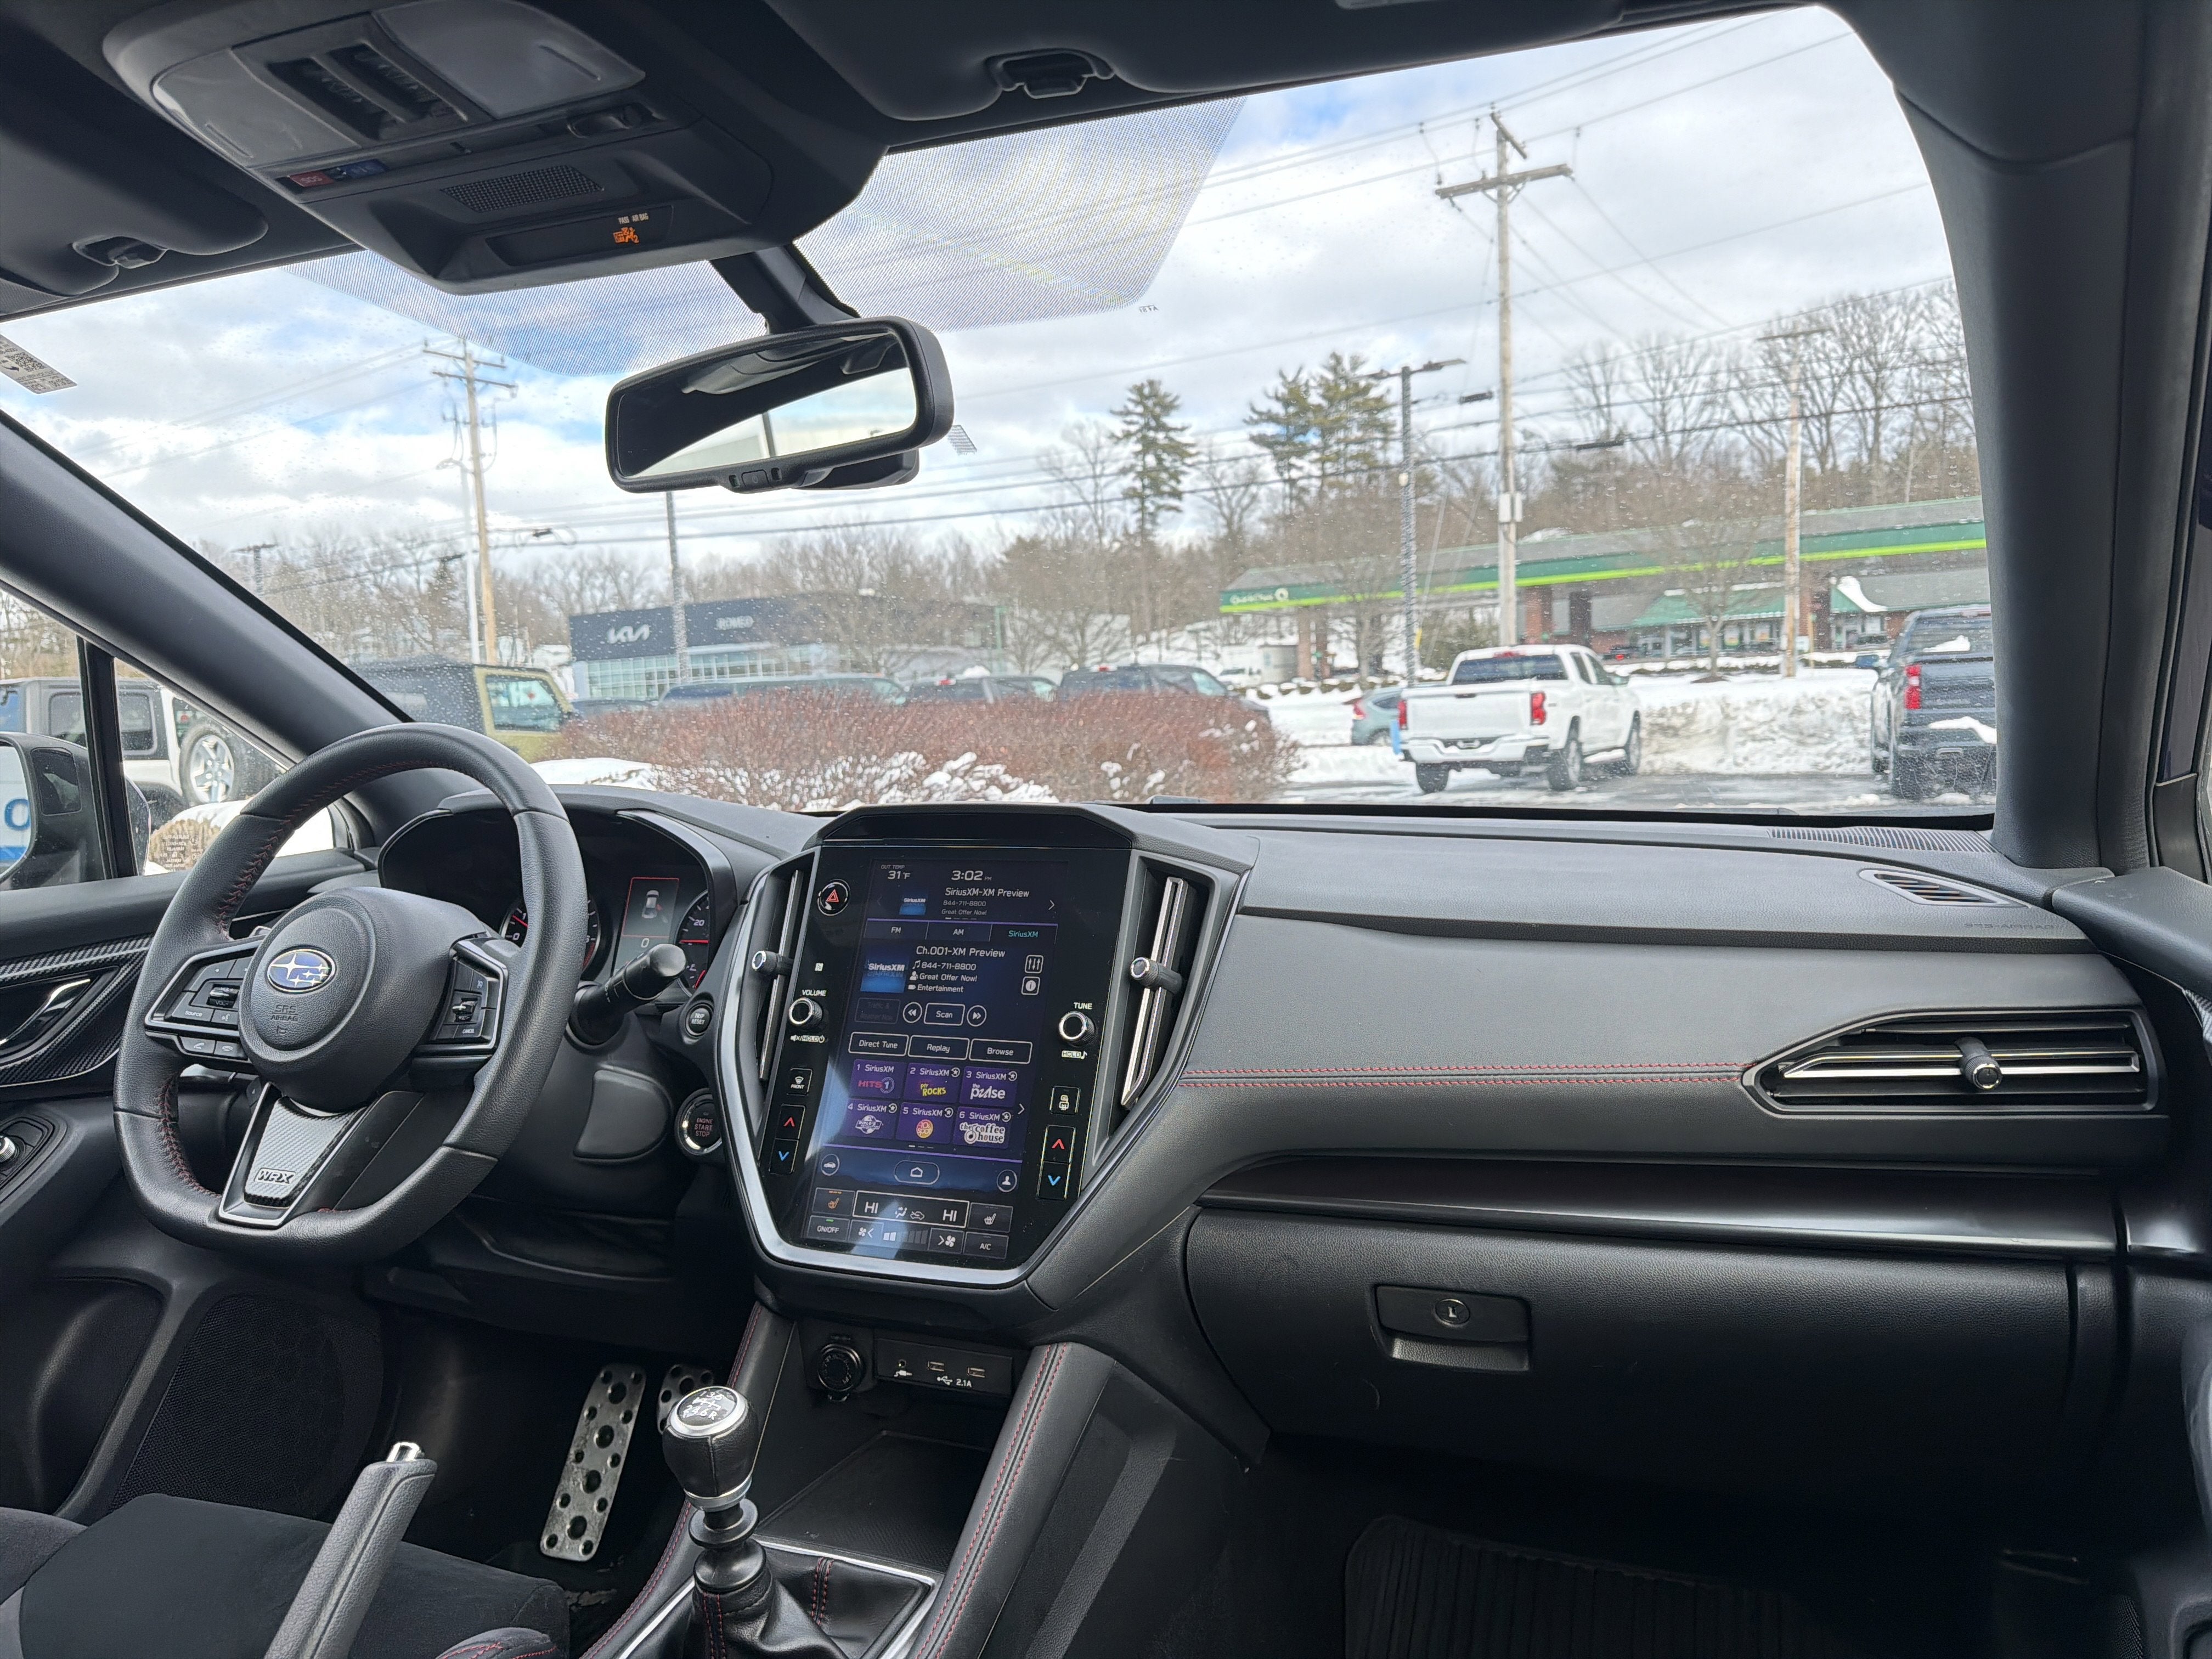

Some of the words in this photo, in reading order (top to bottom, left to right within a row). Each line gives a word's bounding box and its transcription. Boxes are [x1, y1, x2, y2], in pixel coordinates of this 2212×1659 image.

[951, 870, 984, 881] 3:02
[945, 887, 995, 898] SiriusXM-XM
[997, 889, 1030, 898] Preview
[1008, 930, 1039, 938] SiriusXM
[641, 938, 650, 948] 0
[916, 945, 966, 957] Ch.001-XM
[969, 947, 1006, 958] Preview
[868, 962, 905, 972] SiriusXM
[921, 961, 977, 970] 844-711-8800
[919, 973, 939, 981] Great
[940, 973, 959, 982] Offer
[961, 974, 978, 983] Now!
[802, 989, 827, 997] VOLUME
[917, 984, 964, 993] Entertainment
[275, 1005, 297, 1013] SRS
[1073, 1002, 1093, 1010] TUNE
[935, 1010, 953, 1019] Scan
[859, 1040, 879, 1048] Direct
[882, 1041, 898, 1049] Tune
[927, 1043, 950, 1053] Replay
[986, 1047, 1014, 1056] Browse
[865, 1064, 894, 1073] SiriusXM
[919, 1068, 950, 1076] SiriusXM
[975, 1071, 1006, 1080] SiriusXM
[858, 1080, 883, 1088] HITS
[922, 1087, 946, 1097] ROCKS
[970, 1086, 1006, 1100] pulse
[857, 1103, 887, 1113] SiriusXM
[912, 1107, 943, 1116] SiriusXM
[969, 1111, 1000, 1121] SiriusXM
[694, 1123, 713, 1131] START
[975, 1123, 1005, 1134] coffee
[977, 1132, 1003, 1142] house
[257, 1170, 295, 1184] WRX
[864, 1201, 879, 1214] HI
[943, 1209, 957, 1222] HI
[816, 1225, 839, 1234] ON/OFF
[979, 1243, 992, 1251] A/C
[956, 1378, 972, 1388] 2.1A
